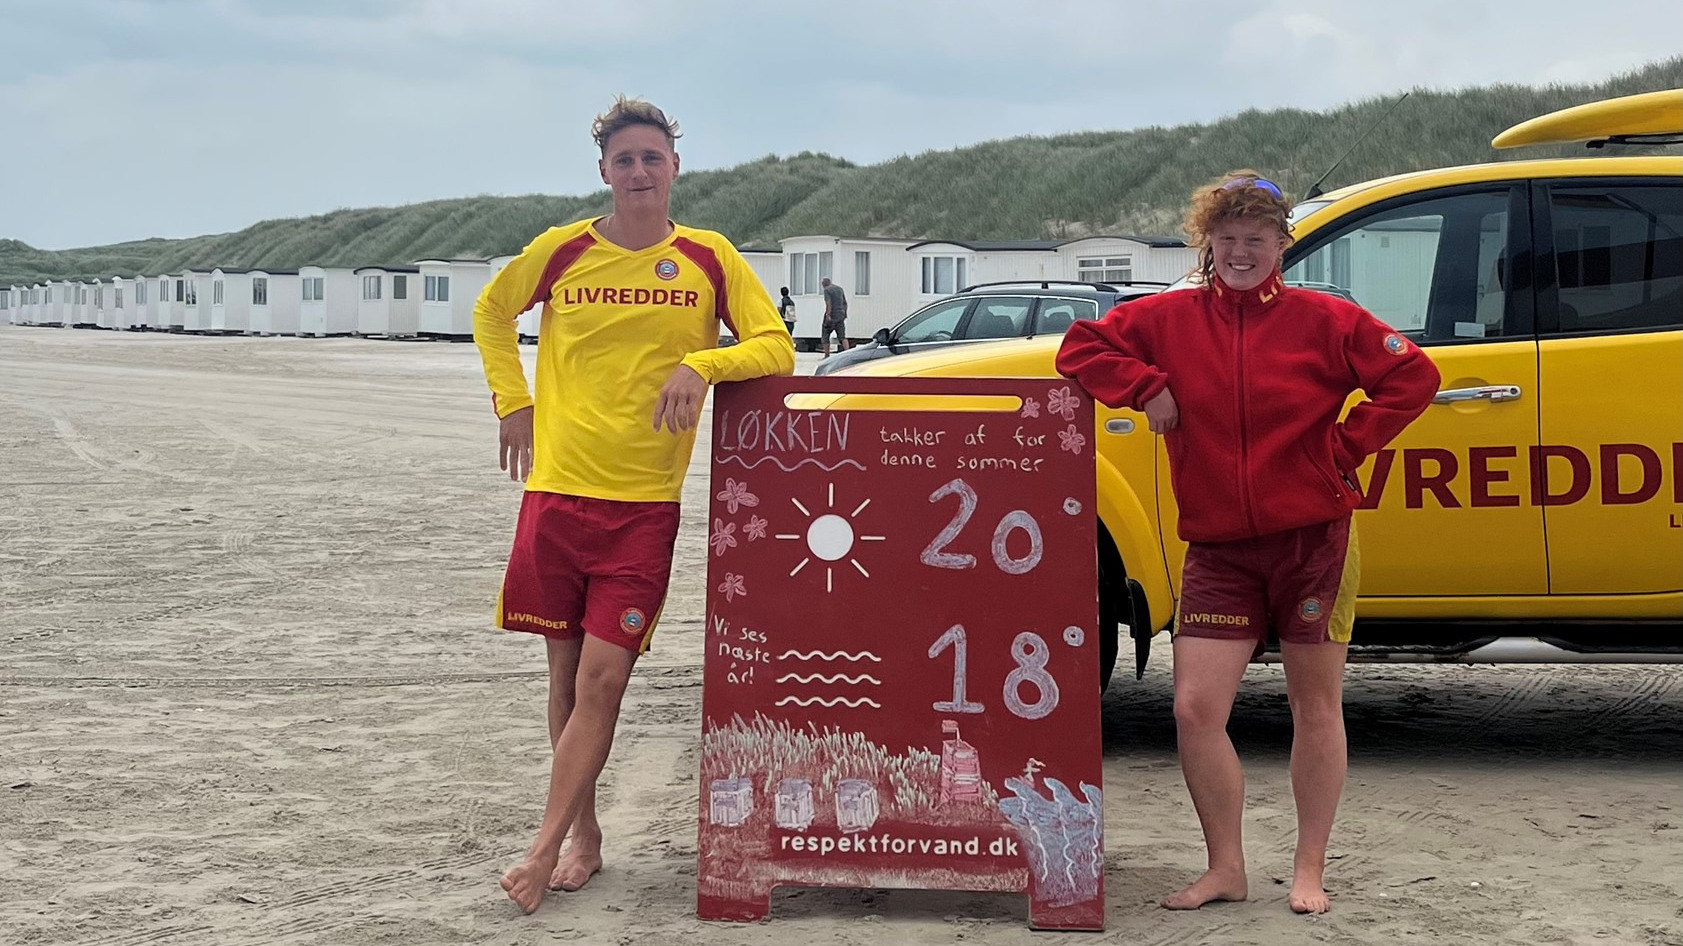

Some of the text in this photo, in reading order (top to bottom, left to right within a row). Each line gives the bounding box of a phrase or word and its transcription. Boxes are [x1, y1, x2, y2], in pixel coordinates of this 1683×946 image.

[564, 287, 699, 307] LIVREDDER
[719, 410, 850, 453] LØKKEN
[880, 424, 1046, 449] takker af for
[880, 449, 1044, 472] denne sommer
[1353, 442, 1683, 510] VREDD
[507, 612, 568, 629] LIVREDDER
[714, 614, 767, 643] Vi ses
[1184, 613, 1249, 626] LIVREDDER
[780, 833, 1018, 857] respektforvand.dk
